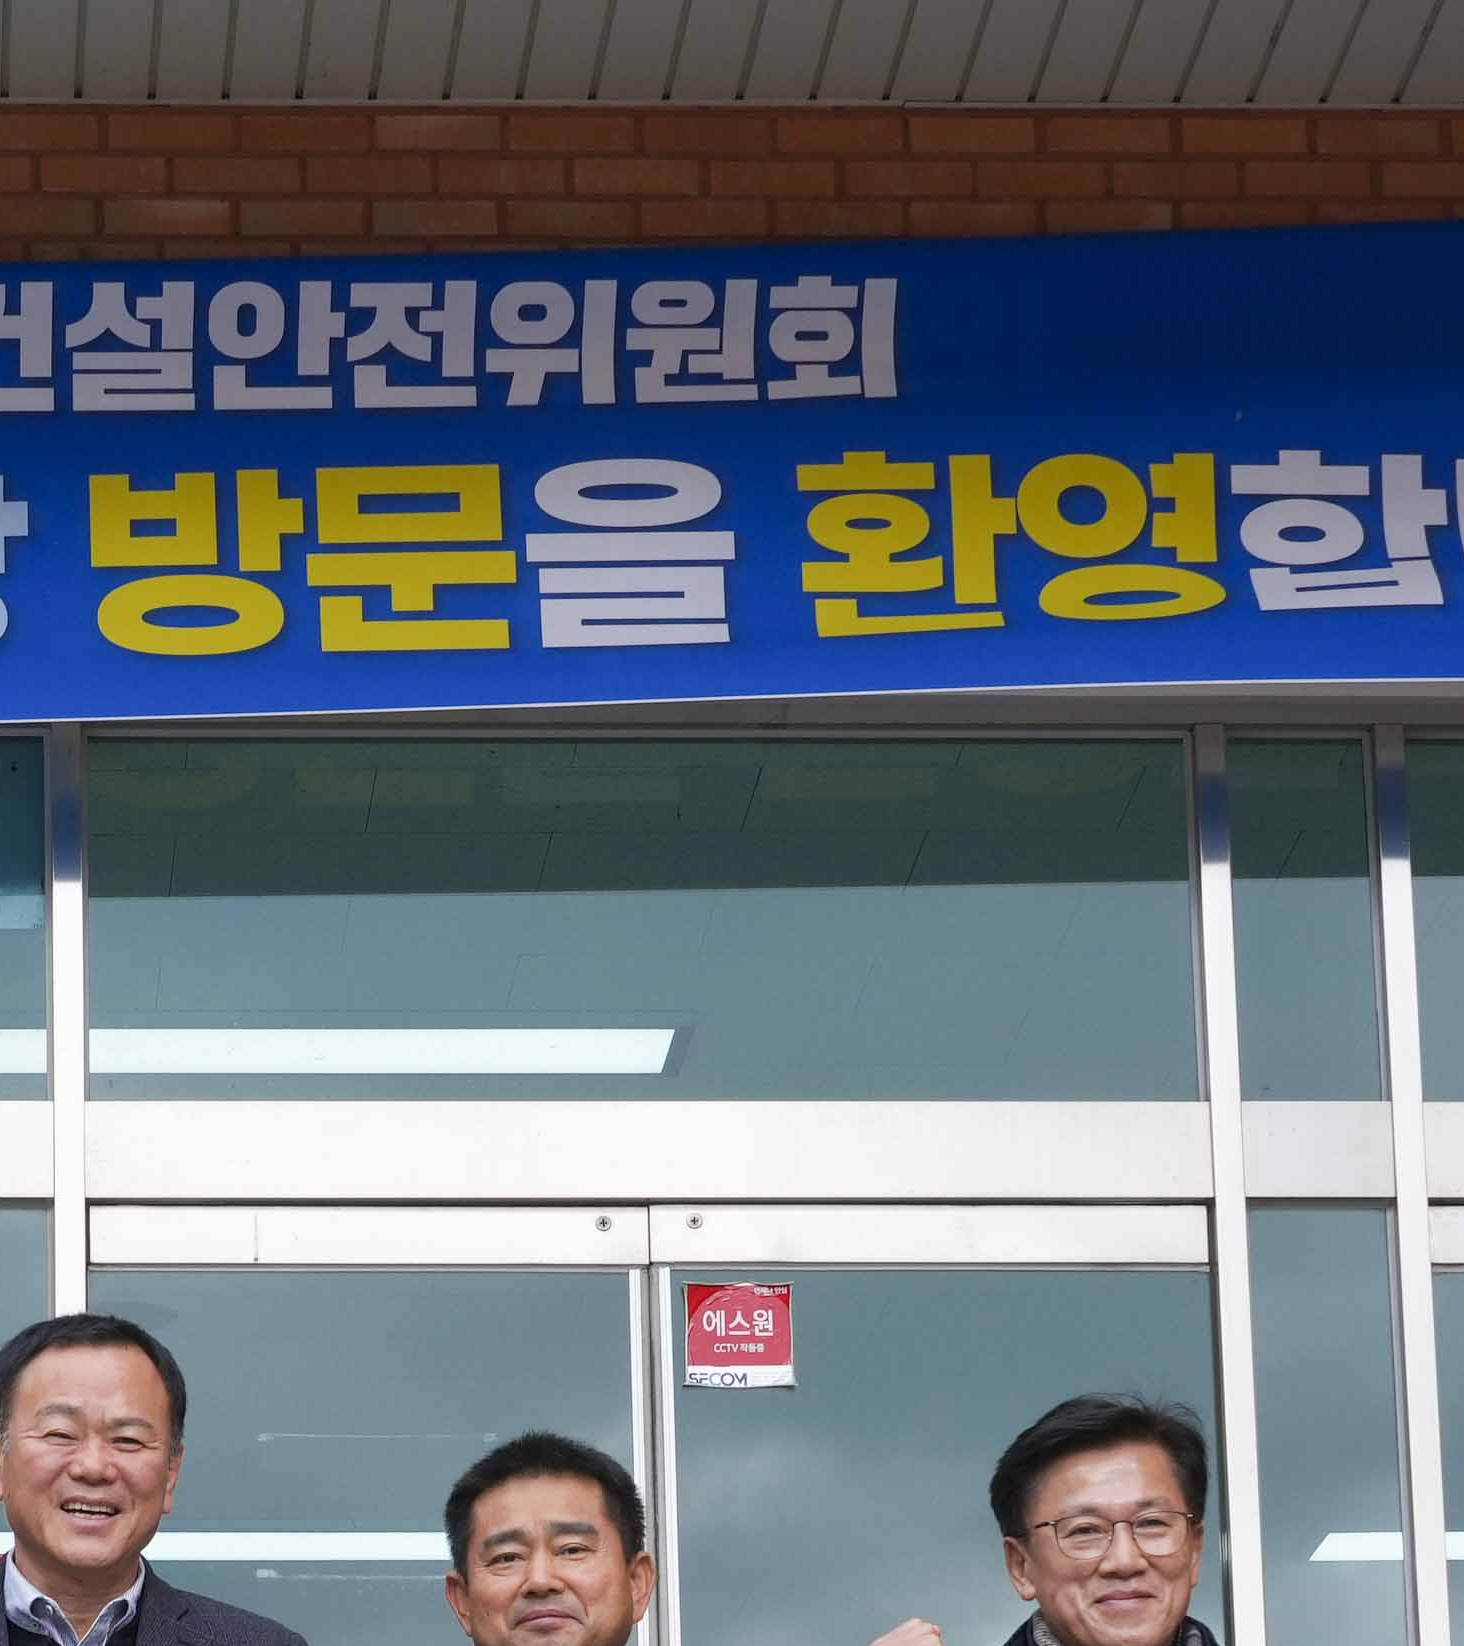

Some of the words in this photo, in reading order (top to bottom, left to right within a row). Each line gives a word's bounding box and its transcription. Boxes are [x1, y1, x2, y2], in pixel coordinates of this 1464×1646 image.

[89, 458, 736, 656] 방문을
[702, 1309, 774, 1337] 에스원
[713, 1343, 739, 1353] CCTV
[688, 1372, 748, 1385] SECOM
